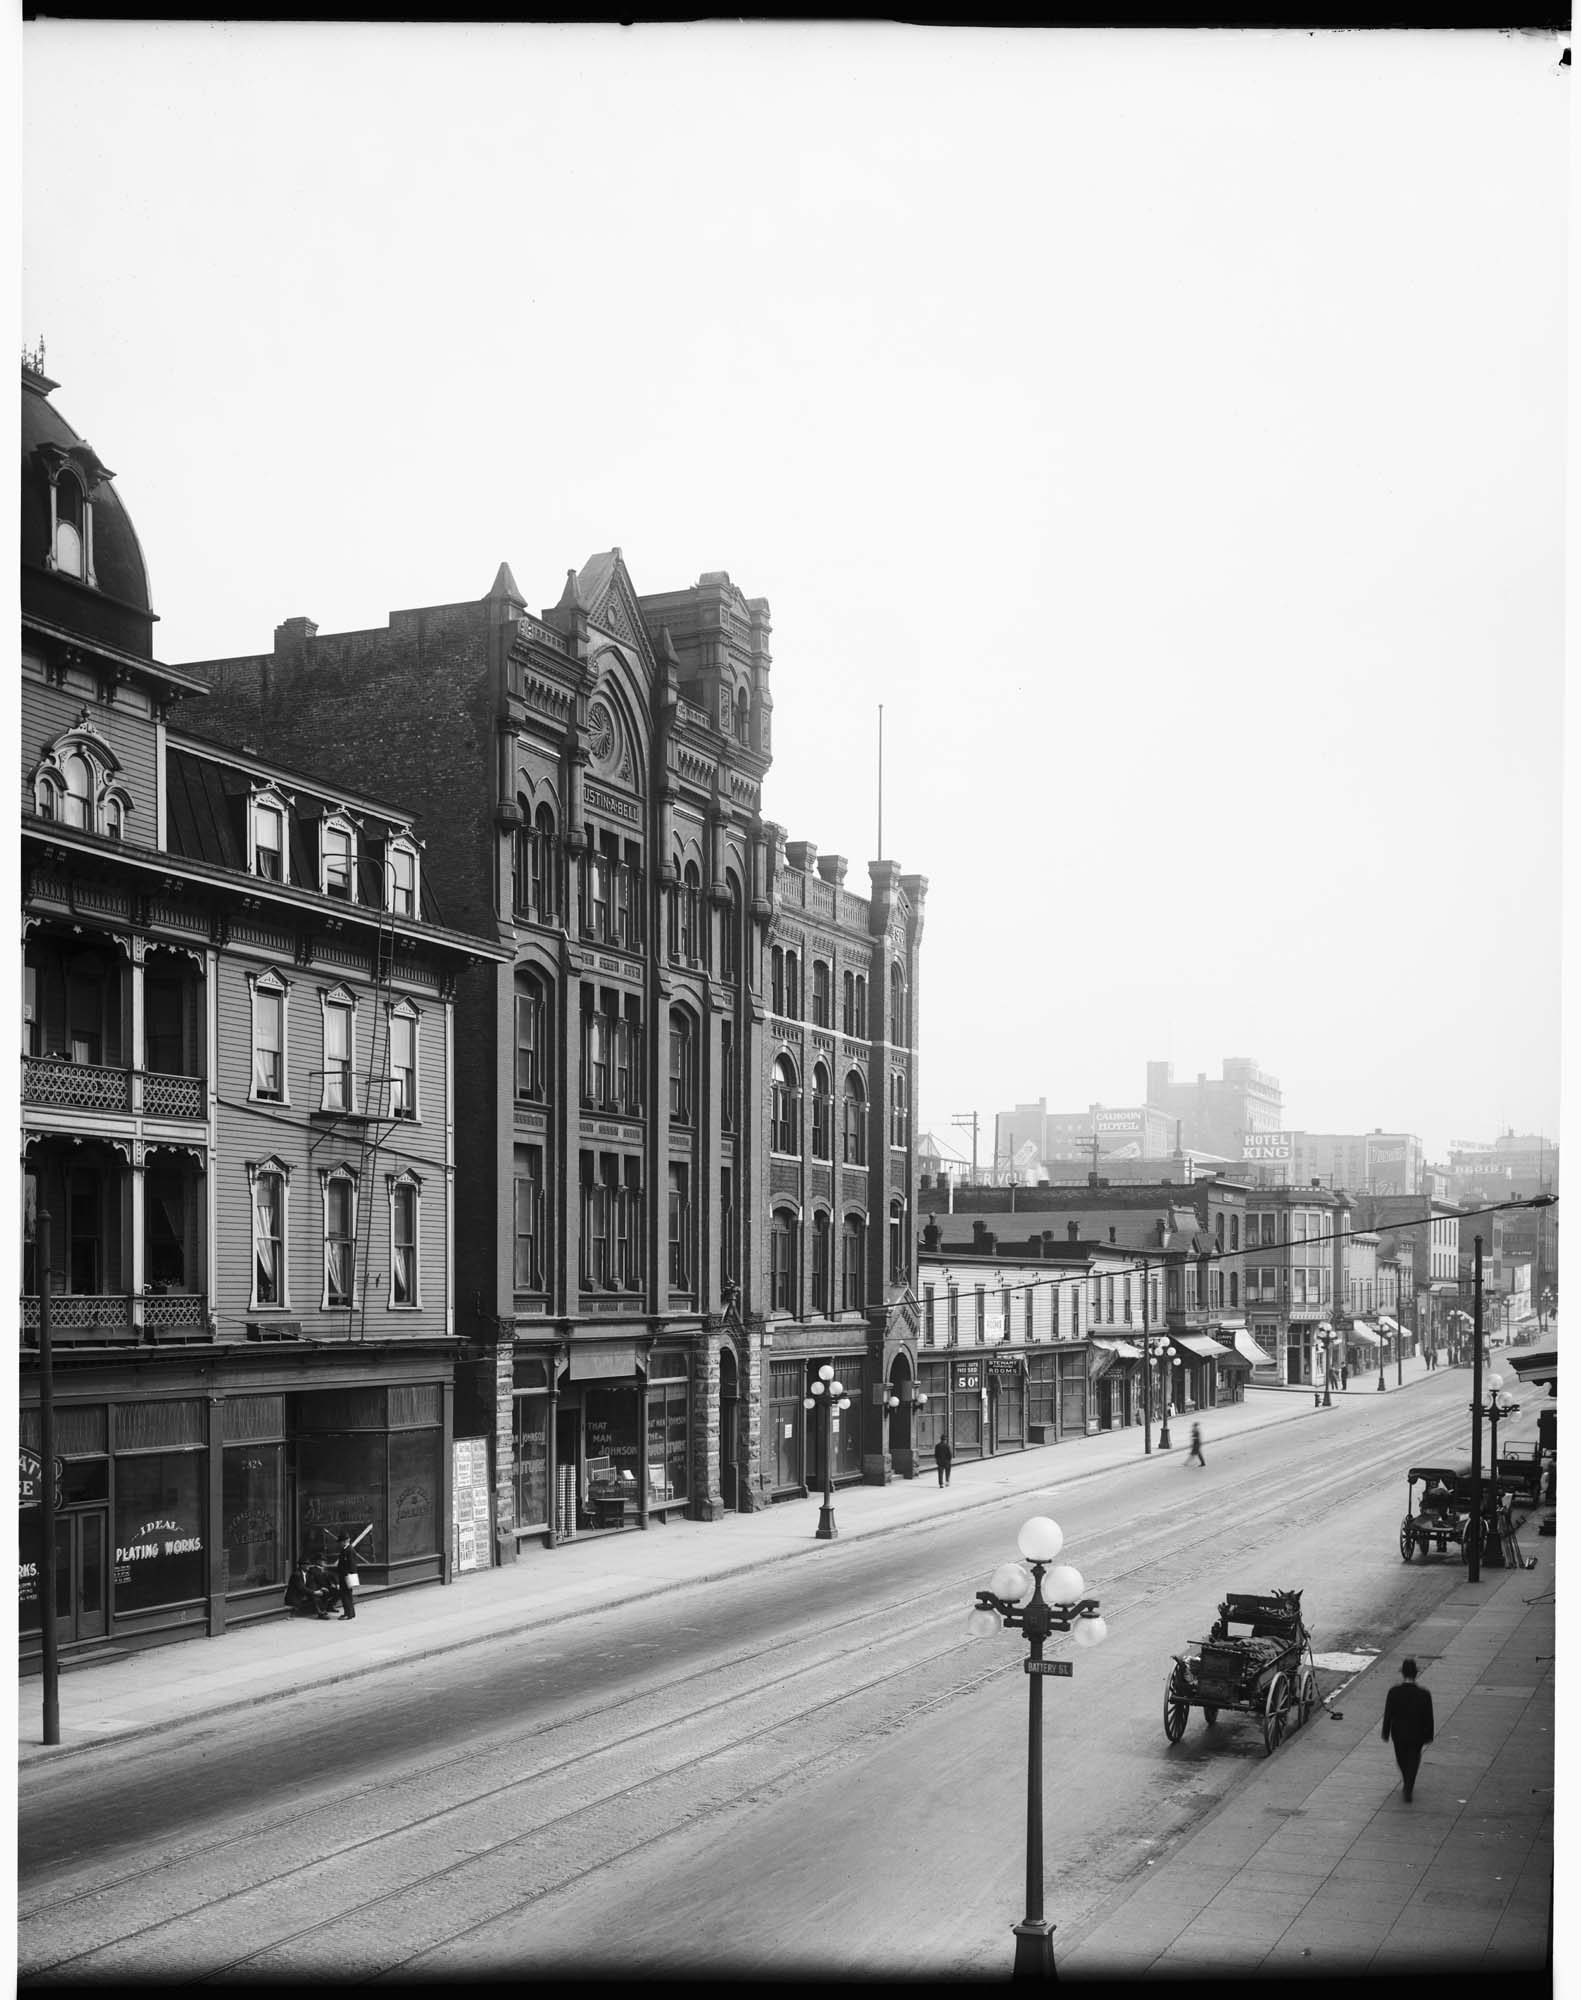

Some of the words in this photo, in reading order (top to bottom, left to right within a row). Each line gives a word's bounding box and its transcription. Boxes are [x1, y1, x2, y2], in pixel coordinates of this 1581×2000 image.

[583, 786, 609, 810] USTIN
[1096, 1111, 1142, 1121] CALHOUN
[1244, 1135, 1289, 1146] HOTEL
[1242, 1147, 1289, 1159] KING
[587, 1422, 608, 1431] THAT
[592, 1433, 612, 1443] MAN
[598, 1444, 639, 1456] JOHNSON
[140, 1519, 178, 1536] IDEAL
[115, 1542, 159, 1563] PLATING
[164, 1536, 204, 1556] WORKS.
[1027, 1662, 1057, 1675] BATTERY
